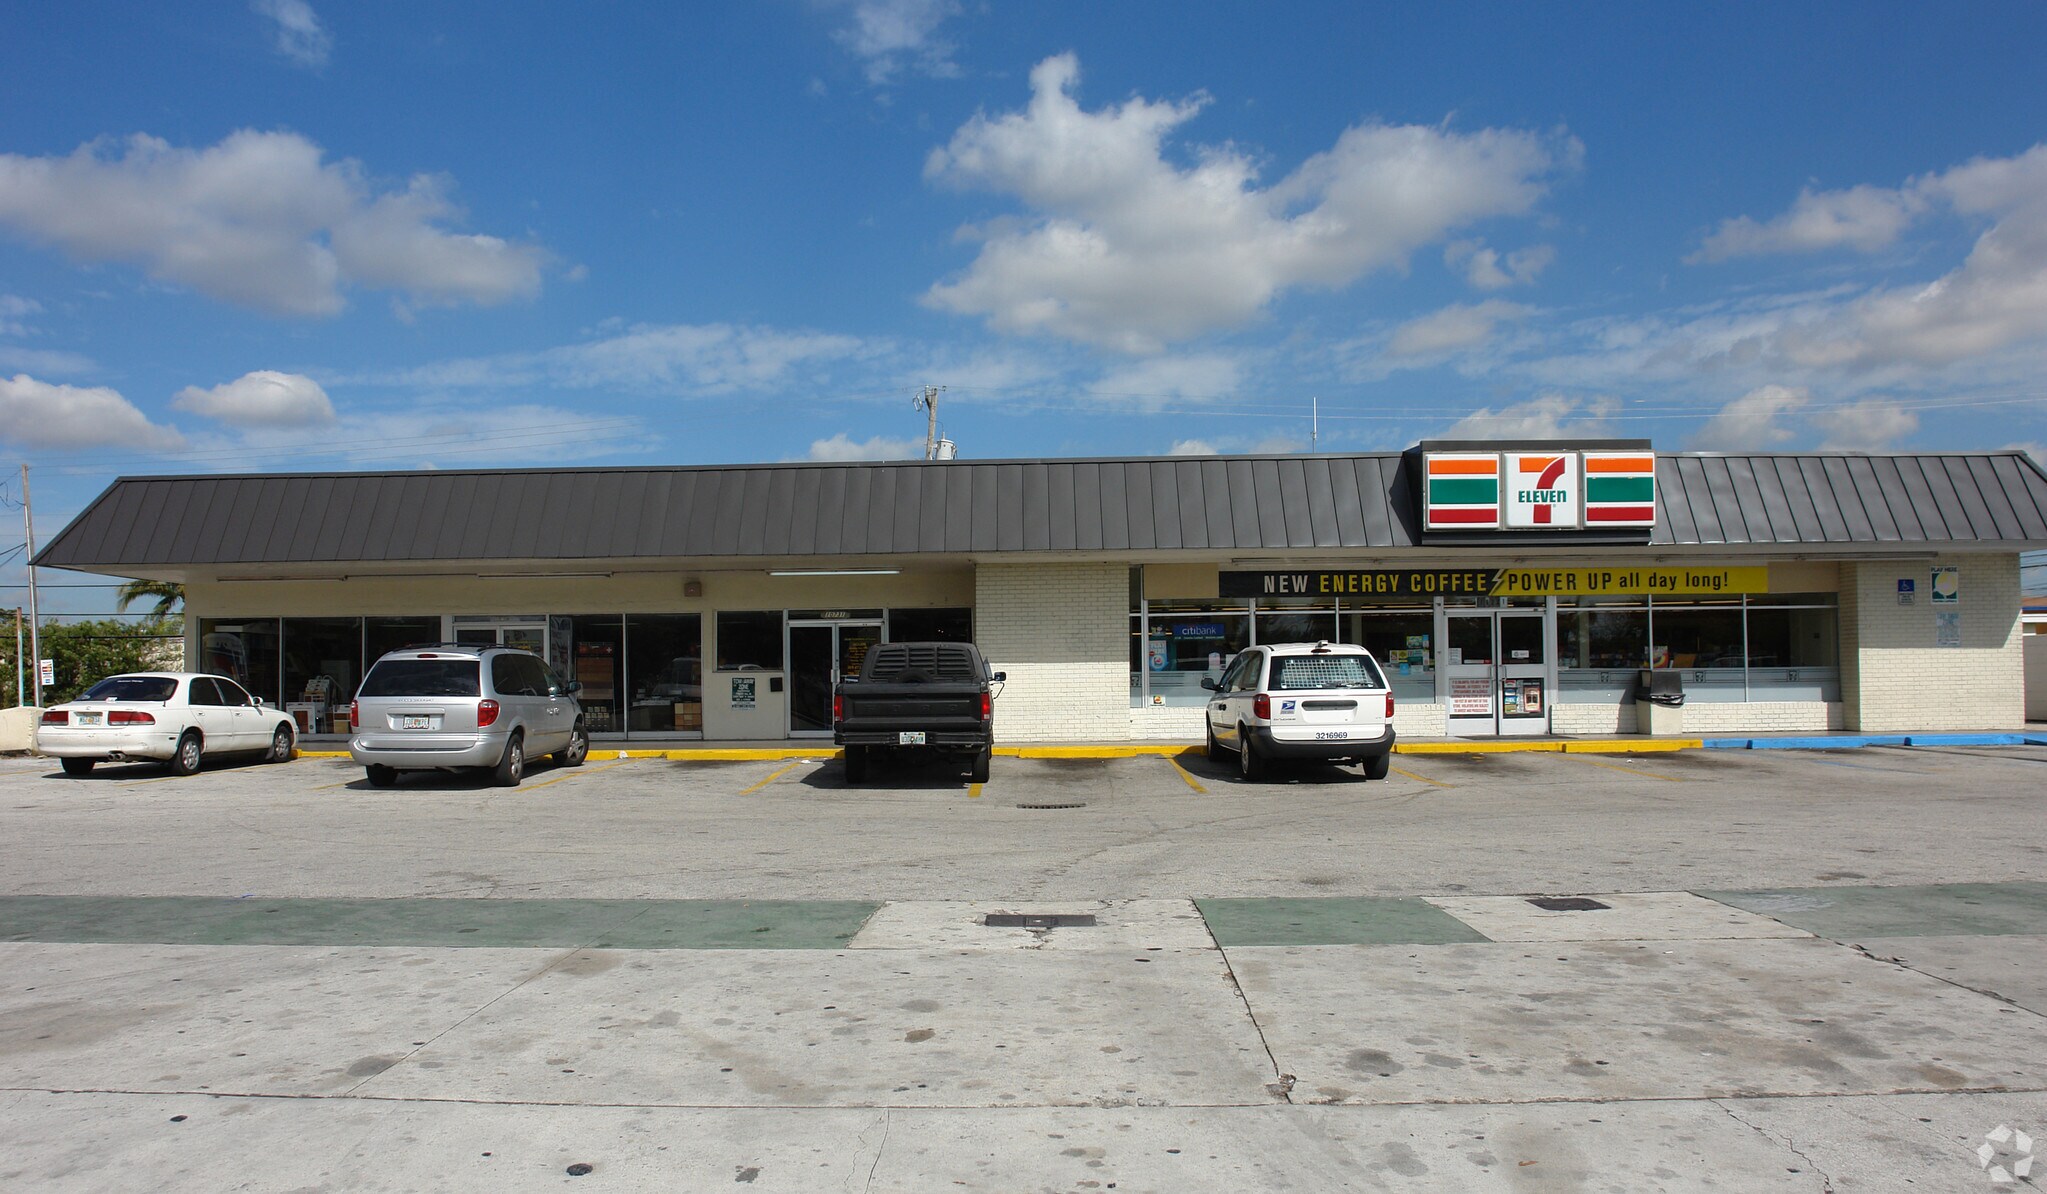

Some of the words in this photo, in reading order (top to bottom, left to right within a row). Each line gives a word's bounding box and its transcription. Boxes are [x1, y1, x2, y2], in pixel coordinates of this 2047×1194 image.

[1263, 574, 1309, 593] NEW
[1319, 573, 1400, 593] ENERGY
[1410, 573, 1488, 592] COFFEE
[1507, 572, 1577, 591] POWER
[1588, 572, 1612, 590] UP
[1619, 571, 1640, 588] all
[1648, 571, 1677, 591] day
[1685, 571, 1729, 590] long!
[1181, 625, 1217, 635] citibank
[1315, 731, 1348, 739] 3216969
